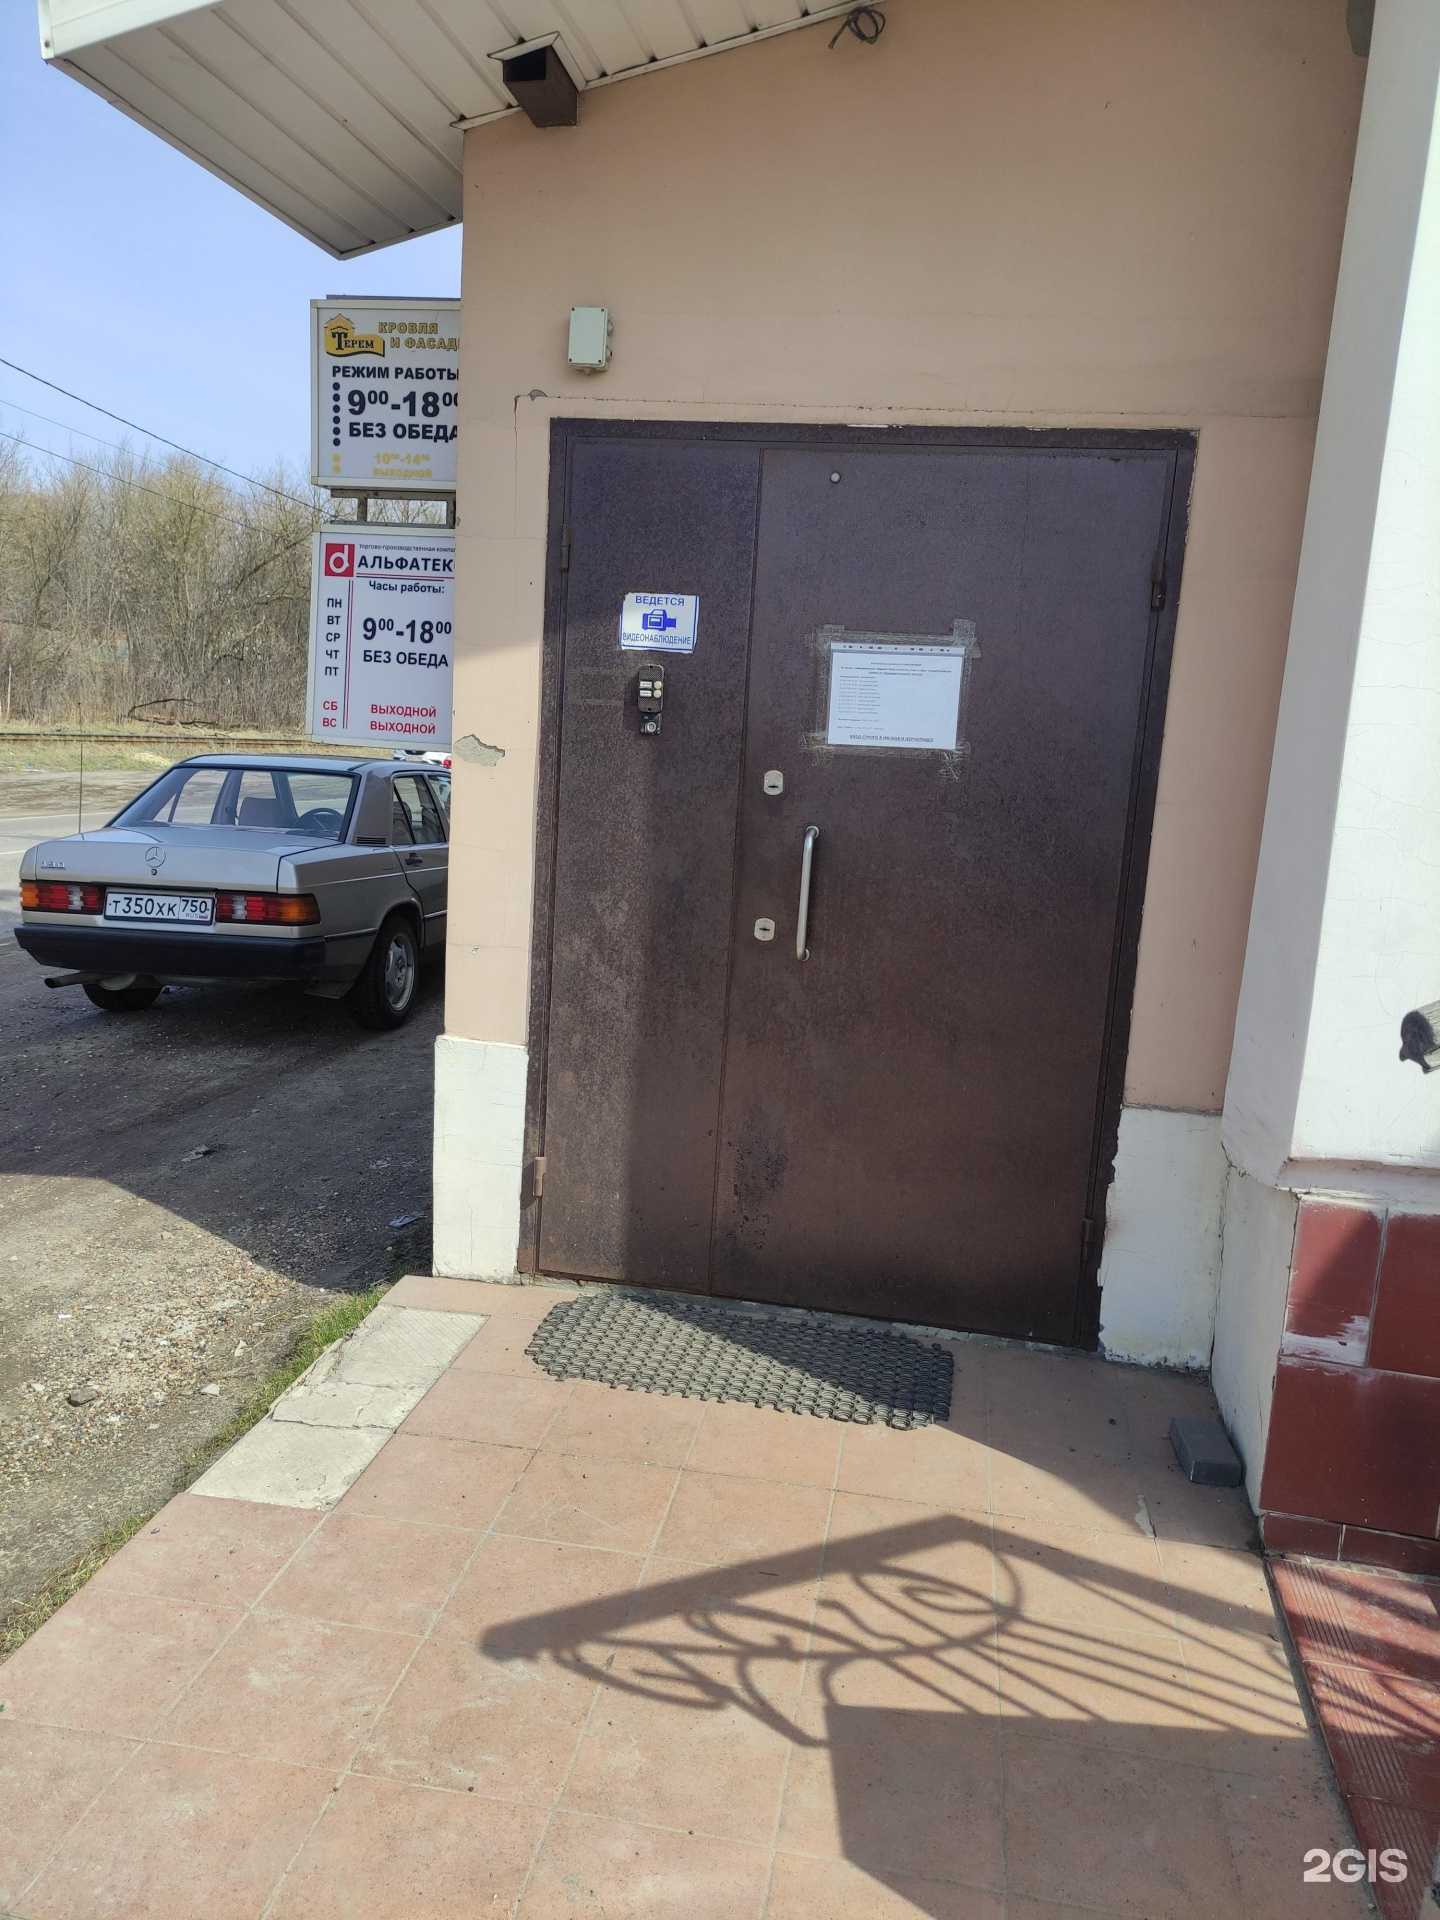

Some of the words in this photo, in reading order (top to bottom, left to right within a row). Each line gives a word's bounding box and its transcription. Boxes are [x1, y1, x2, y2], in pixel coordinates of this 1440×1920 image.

[378, 321, 439, 334] КРОВЛЯ
[390, 337, 400, 348] И
[404, 337, 460, 352] ФАСАД
[332, 365, 389, 379] РЕЖИМ
[395, 366, 459, 381] РАБОТЫ
[349, 422, 386, 438] БЕЗ
[393, 423, 458, 443] ОБЕДА
[357, 554, 455, 573] АЛЬФАТЕК
[369, 580, 398, 591] Часы
[400, 582, 445, 595] работы:
[327, 598, 342, 609] ПН
[635, 595, 685, 607] ВЕДЕТСЯ
[327, 615, 341, 626] ВТ
[326, 632, 341, 643] СР
[622, 632, 693, 645] ВИДЕОНАБЛЮДЕНИЕ
[325, 650, 340, 660] ЧТ
[363, 650, 392, 664] БЕЗ
[396, 651, 449, 669] ОБЕДА
[324, 666, 339, 677] ПТ
[322, 700, 338, 711] СБ
[370, 704, 437, 719] ВЫХОДНОЙ
[322, 717, 337, 728] ВС
[369, 721, 436, 735] ВЫХОДНОЙ
